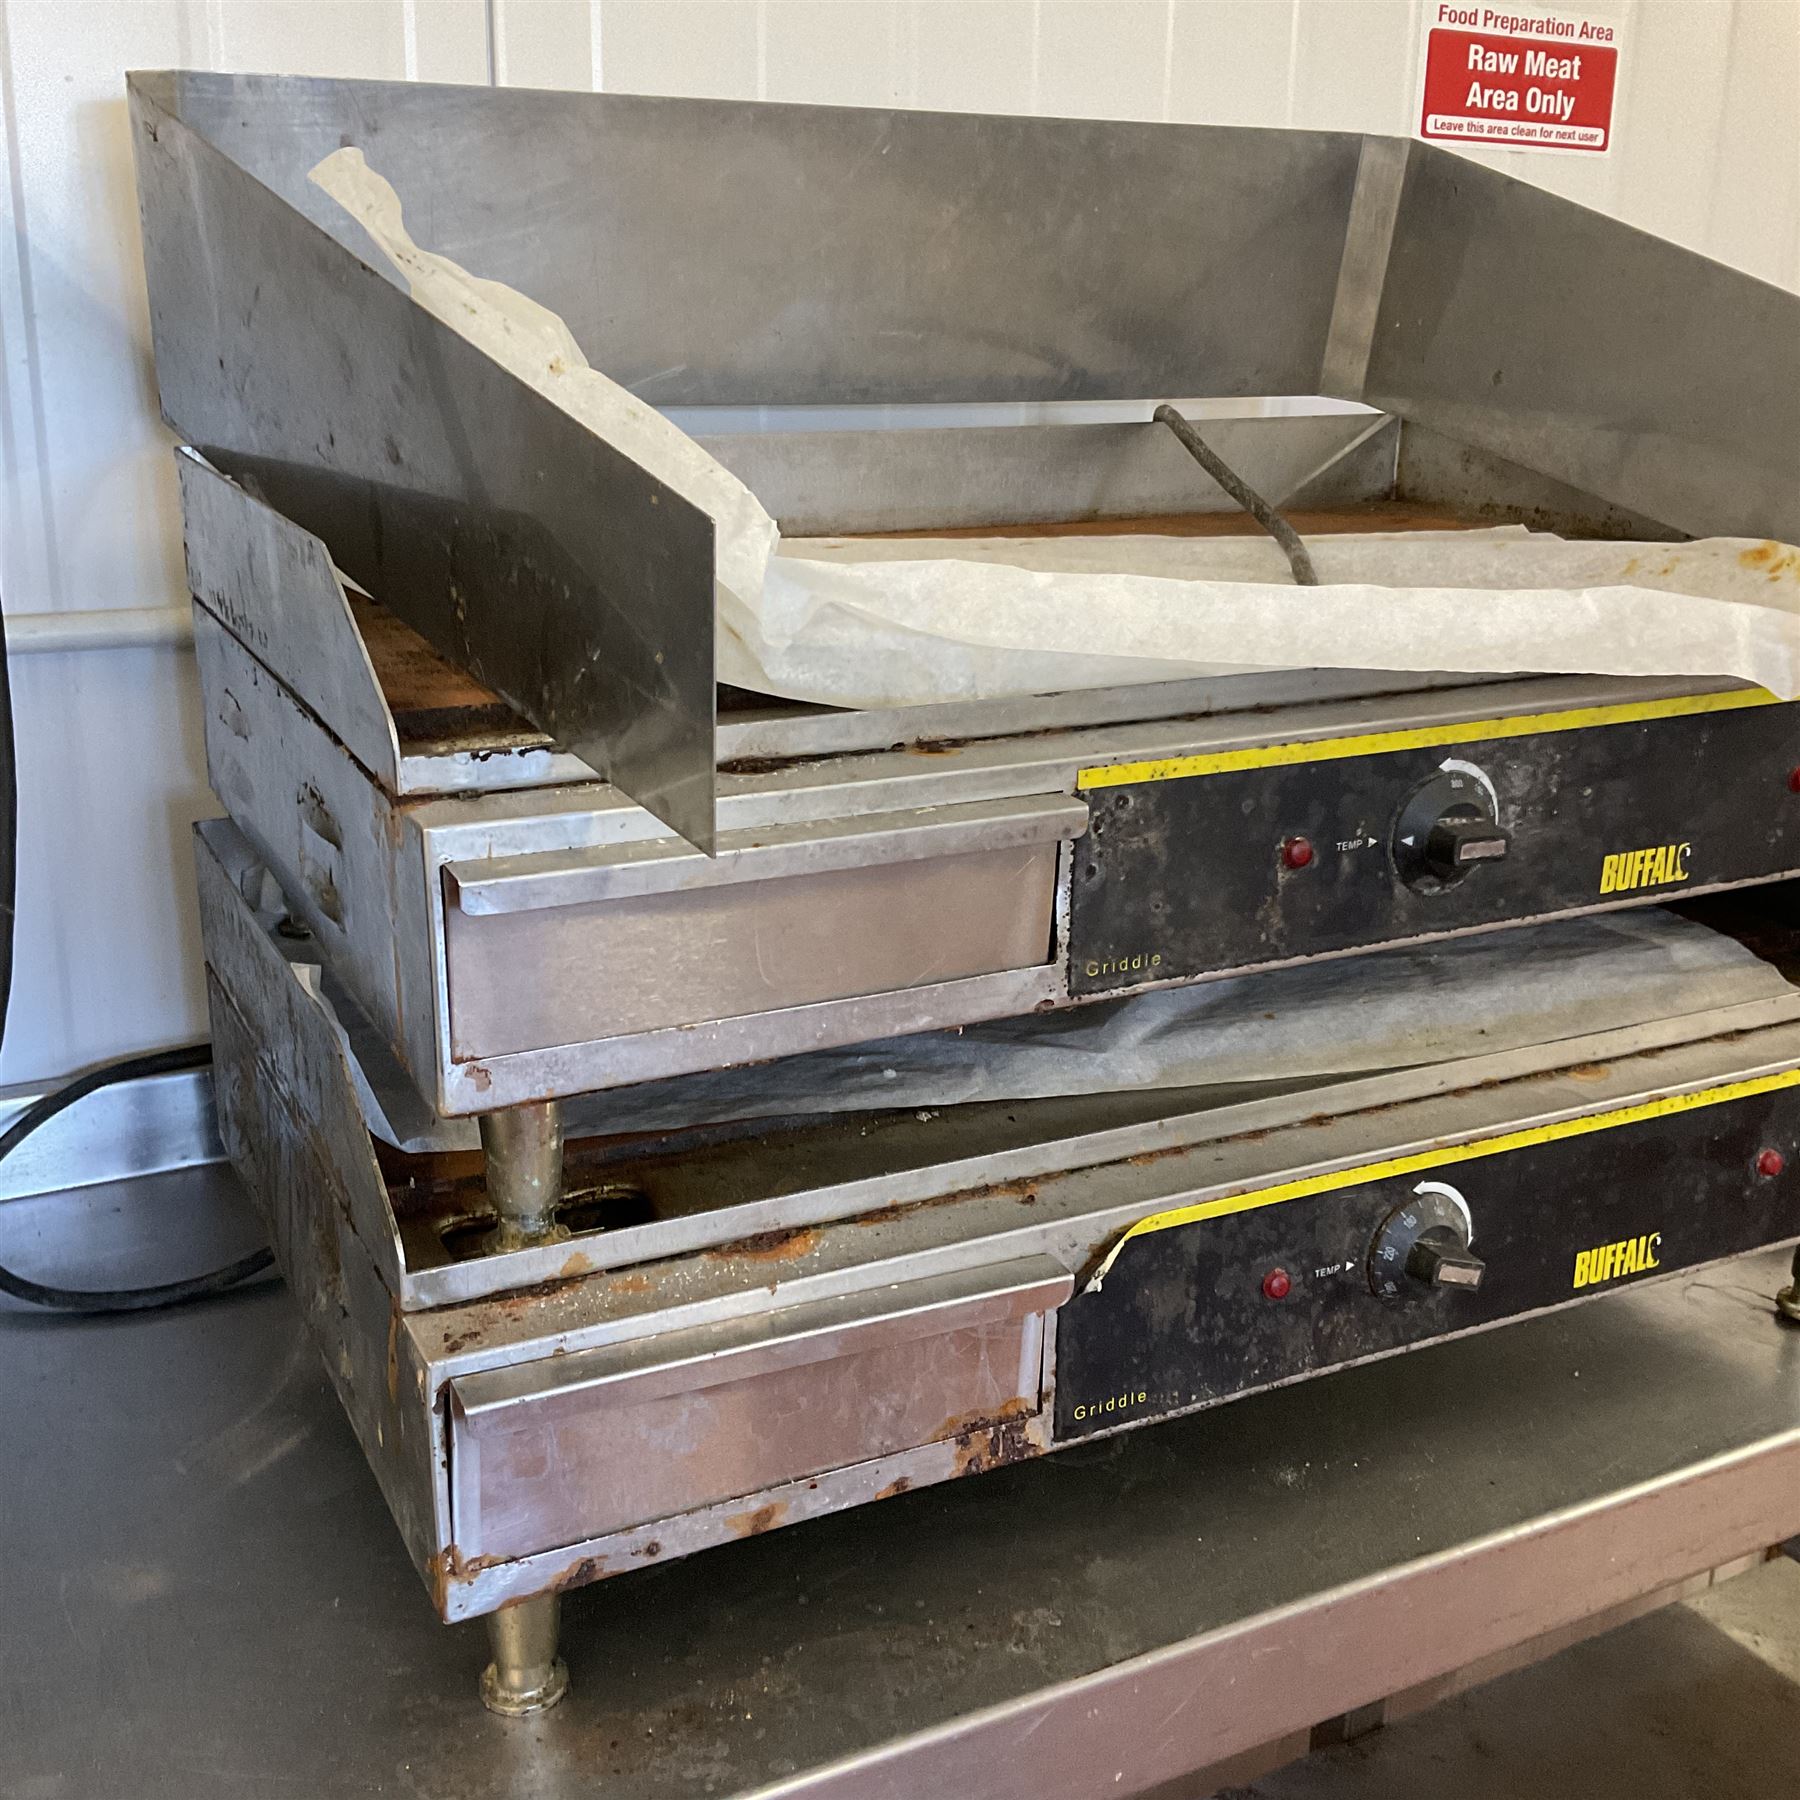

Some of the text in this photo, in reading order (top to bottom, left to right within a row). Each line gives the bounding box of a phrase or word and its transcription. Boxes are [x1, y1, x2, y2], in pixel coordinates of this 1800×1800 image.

[1438, 4, 1614, 41] Food Preparation Area
[1468, 44, 1582, 80] Raw Meat
[1466, 81, 1576, 121] Area Only
[1434, 118, 1599, 143] Leave this area clean for next user
[1336, 838, 1363, 852] TEMP
[1086, 952, 1162, 977] Griddle
[1315, 1263, 1341, 1279] TEMP
[1073, 1390, 1149, 1421] Griddle
